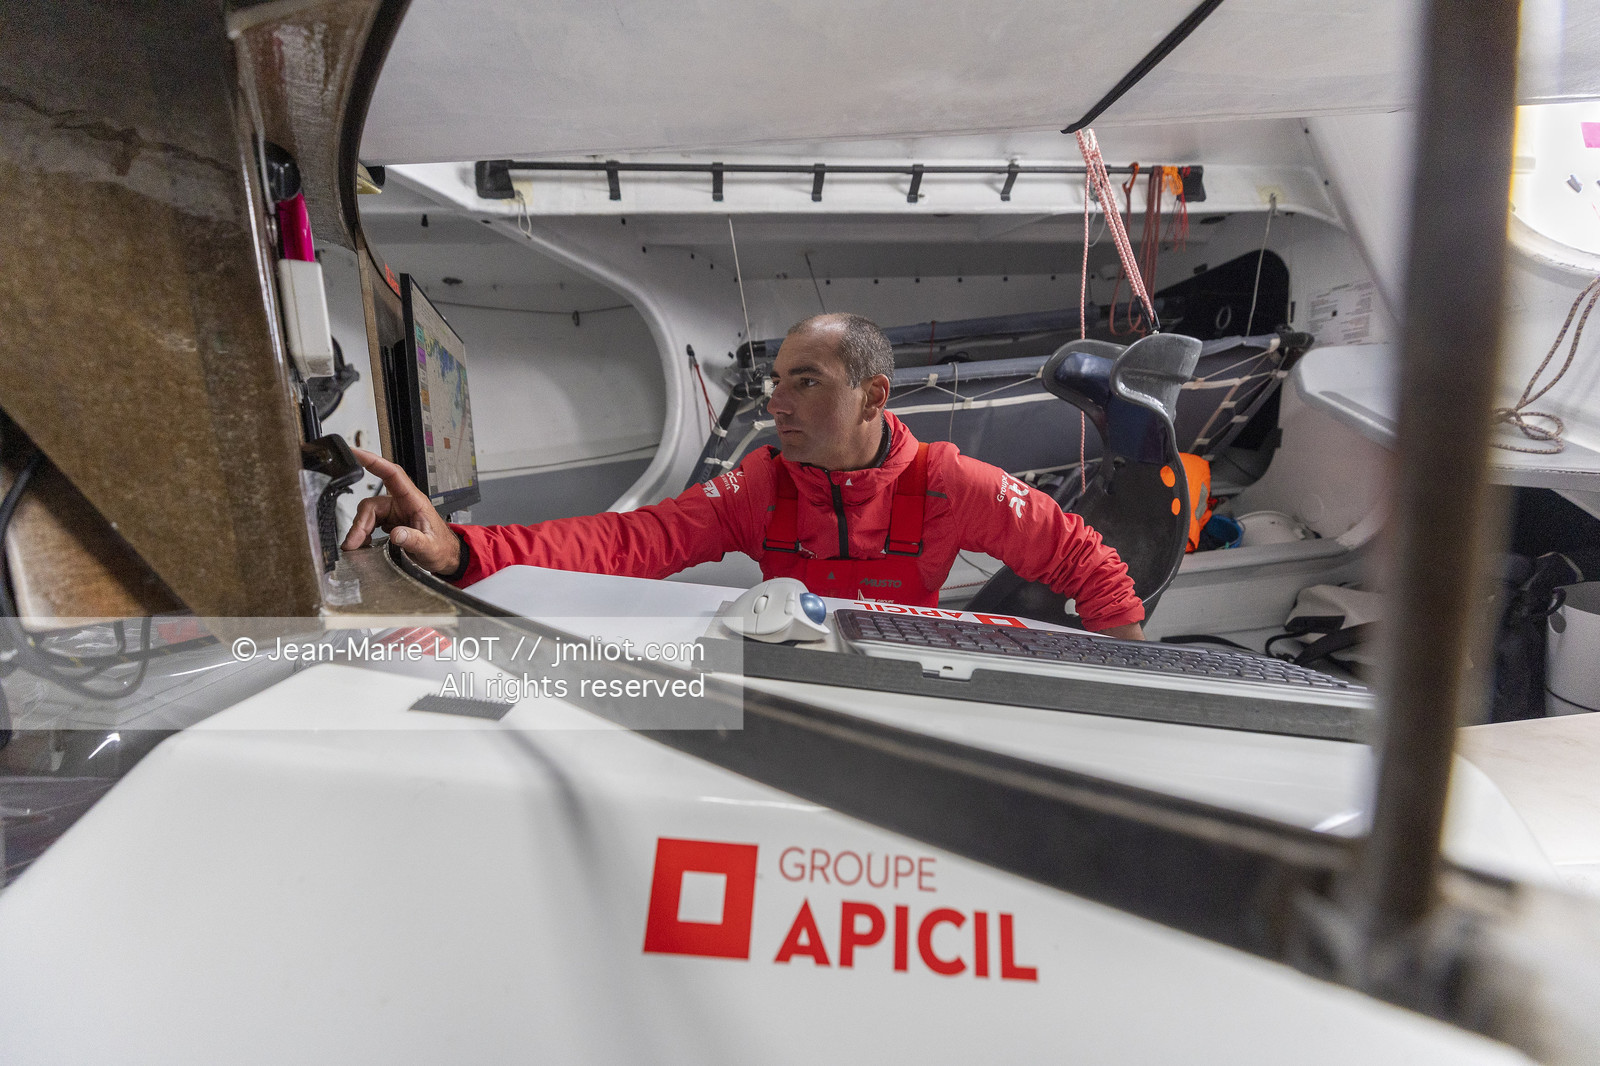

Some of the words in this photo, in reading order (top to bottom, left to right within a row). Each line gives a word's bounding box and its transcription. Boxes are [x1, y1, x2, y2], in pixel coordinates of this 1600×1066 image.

[859, 577, 903, 589] MUSTO
[853, 601, 963, 620] APICIL
[778, 846, 936, 892] GROUPE
[772, 897, 1039, 983] APICIL
